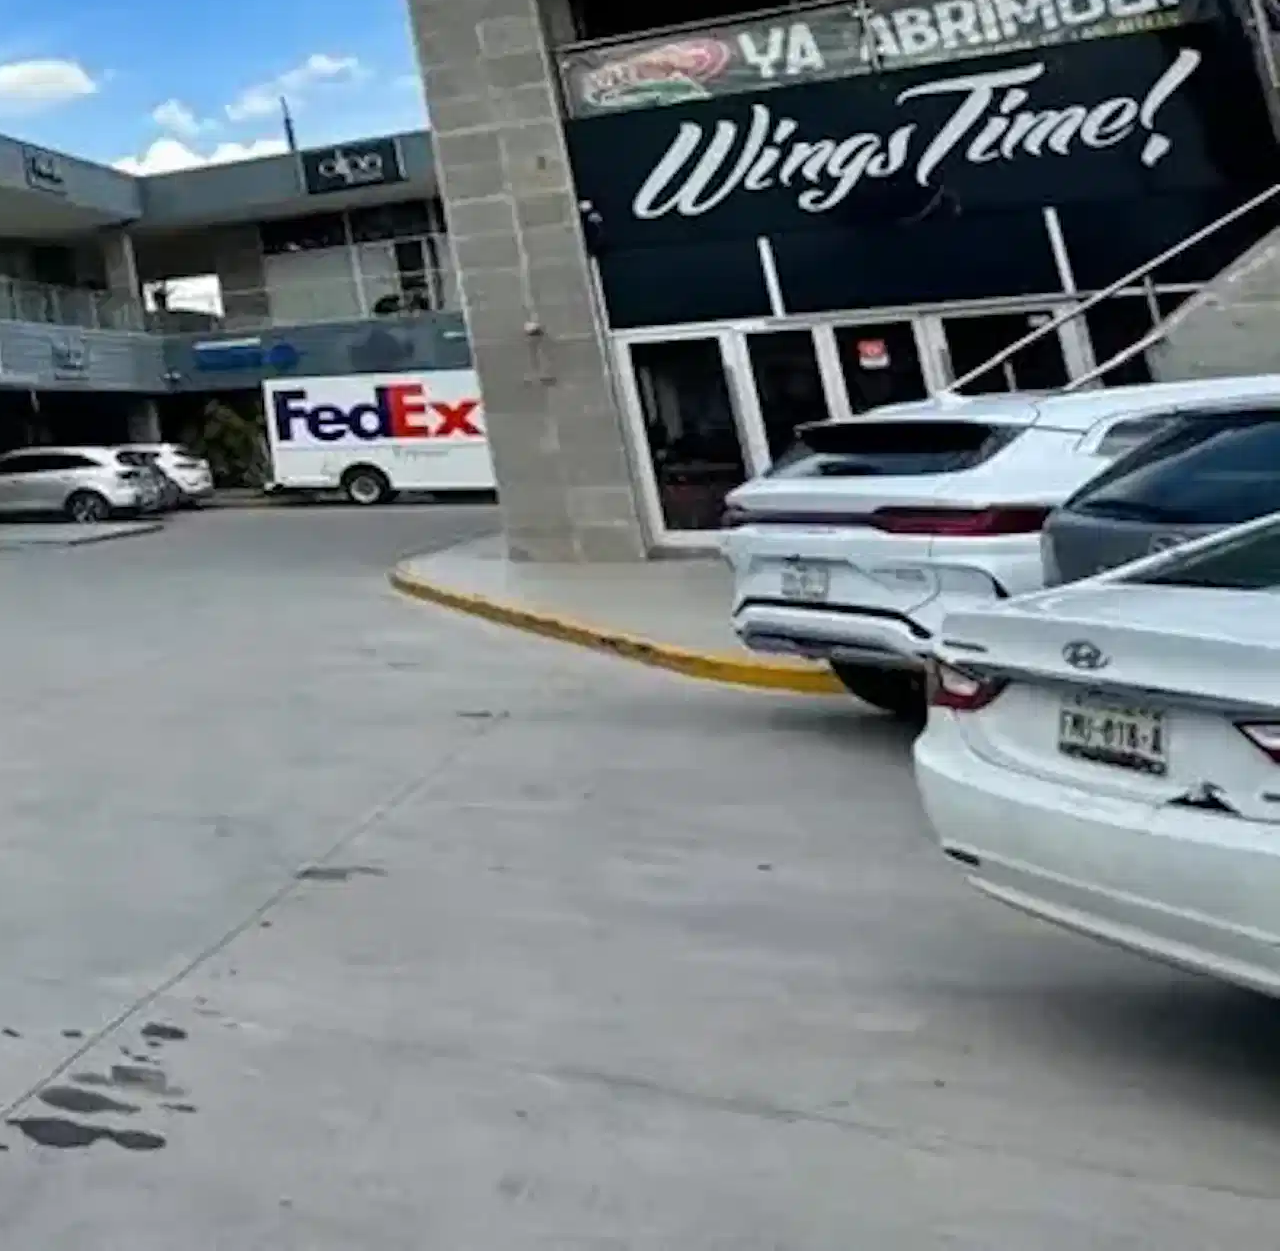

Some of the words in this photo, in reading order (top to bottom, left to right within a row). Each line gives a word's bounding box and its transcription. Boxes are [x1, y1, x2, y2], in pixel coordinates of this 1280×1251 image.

[738, 22, 826, 79] YA
[632, 104, 918, 219] Wings
[896, 49, 1201, 187] Time!
[274, 383, 482, 441] FedEx
